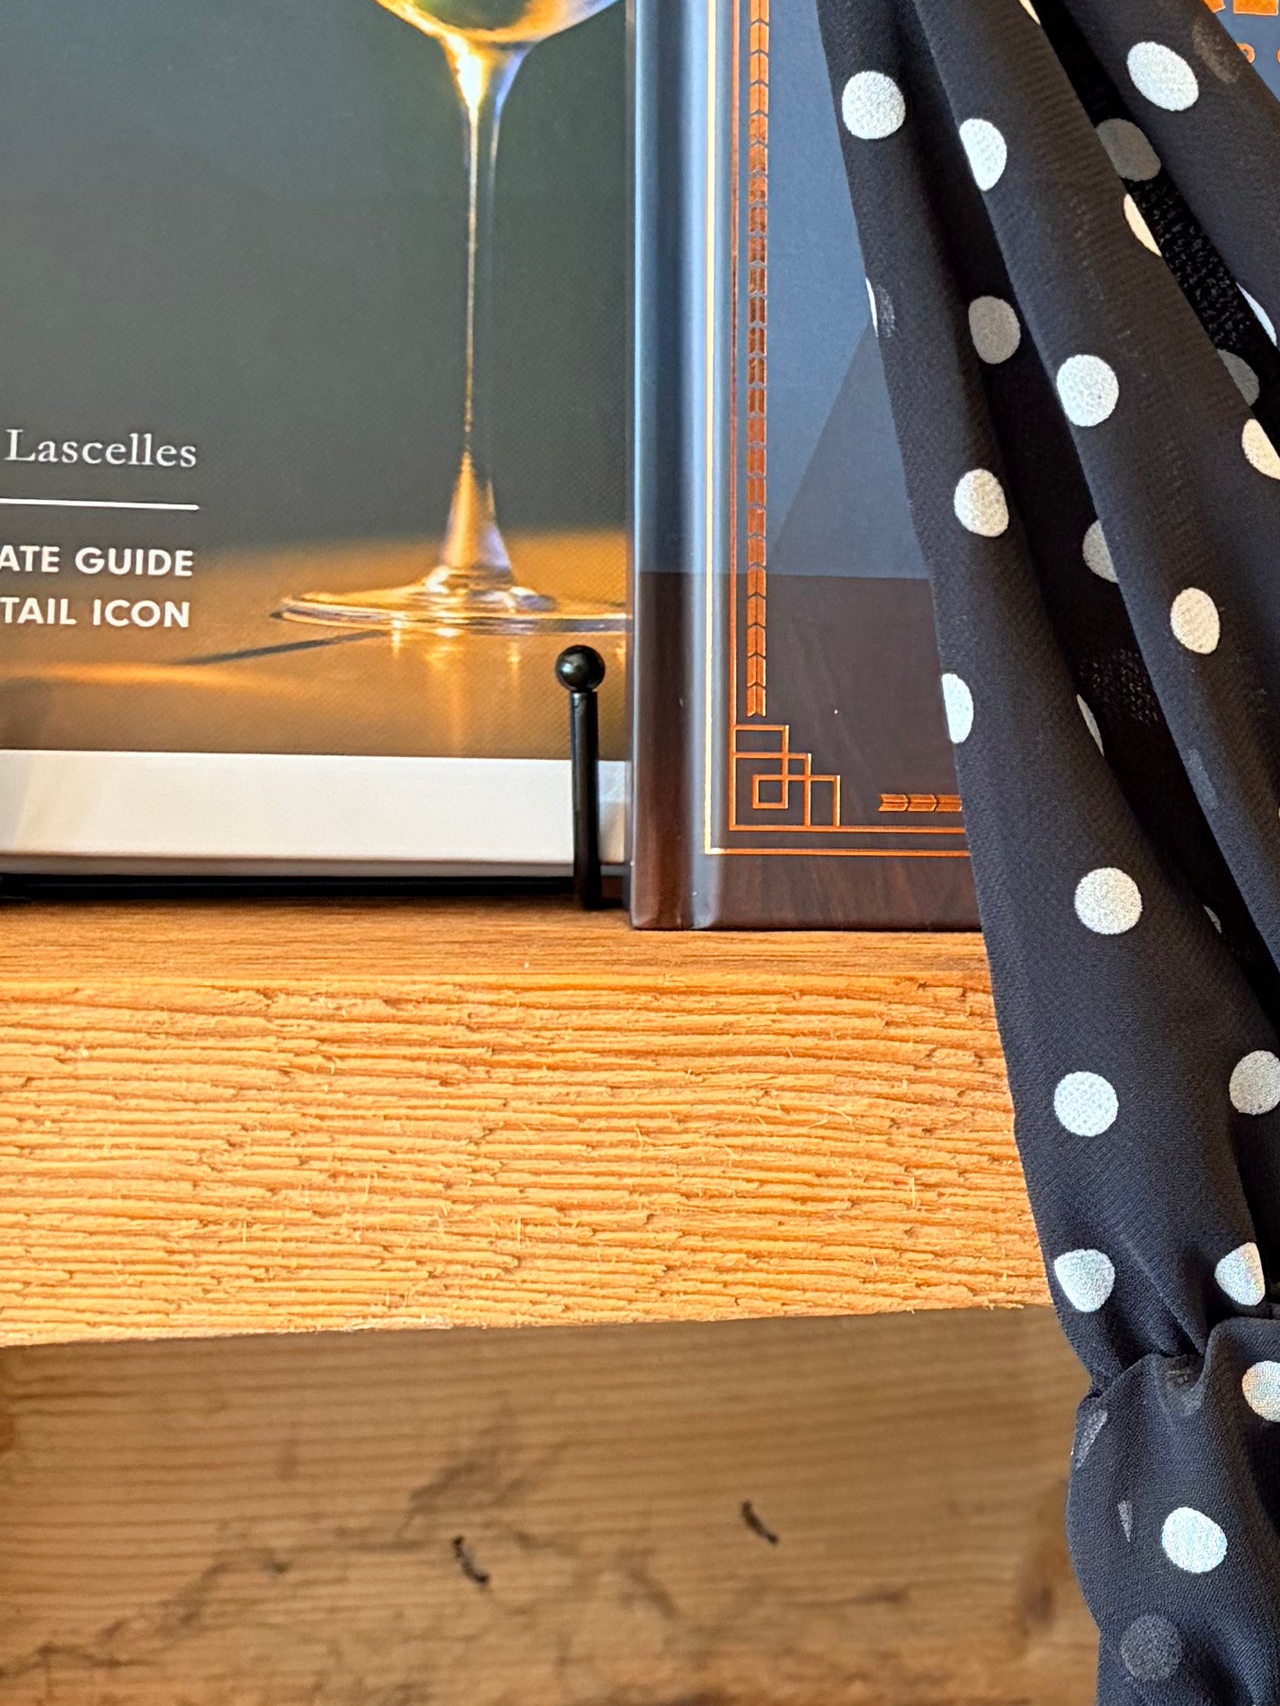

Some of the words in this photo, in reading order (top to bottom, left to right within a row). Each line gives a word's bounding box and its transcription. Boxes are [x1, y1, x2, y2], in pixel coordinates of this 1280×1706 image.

[4, 428, 198, 469] Lascelles
[74, 546, 194, 577] GUIDE
[92, 599, 190, 628] ICON
